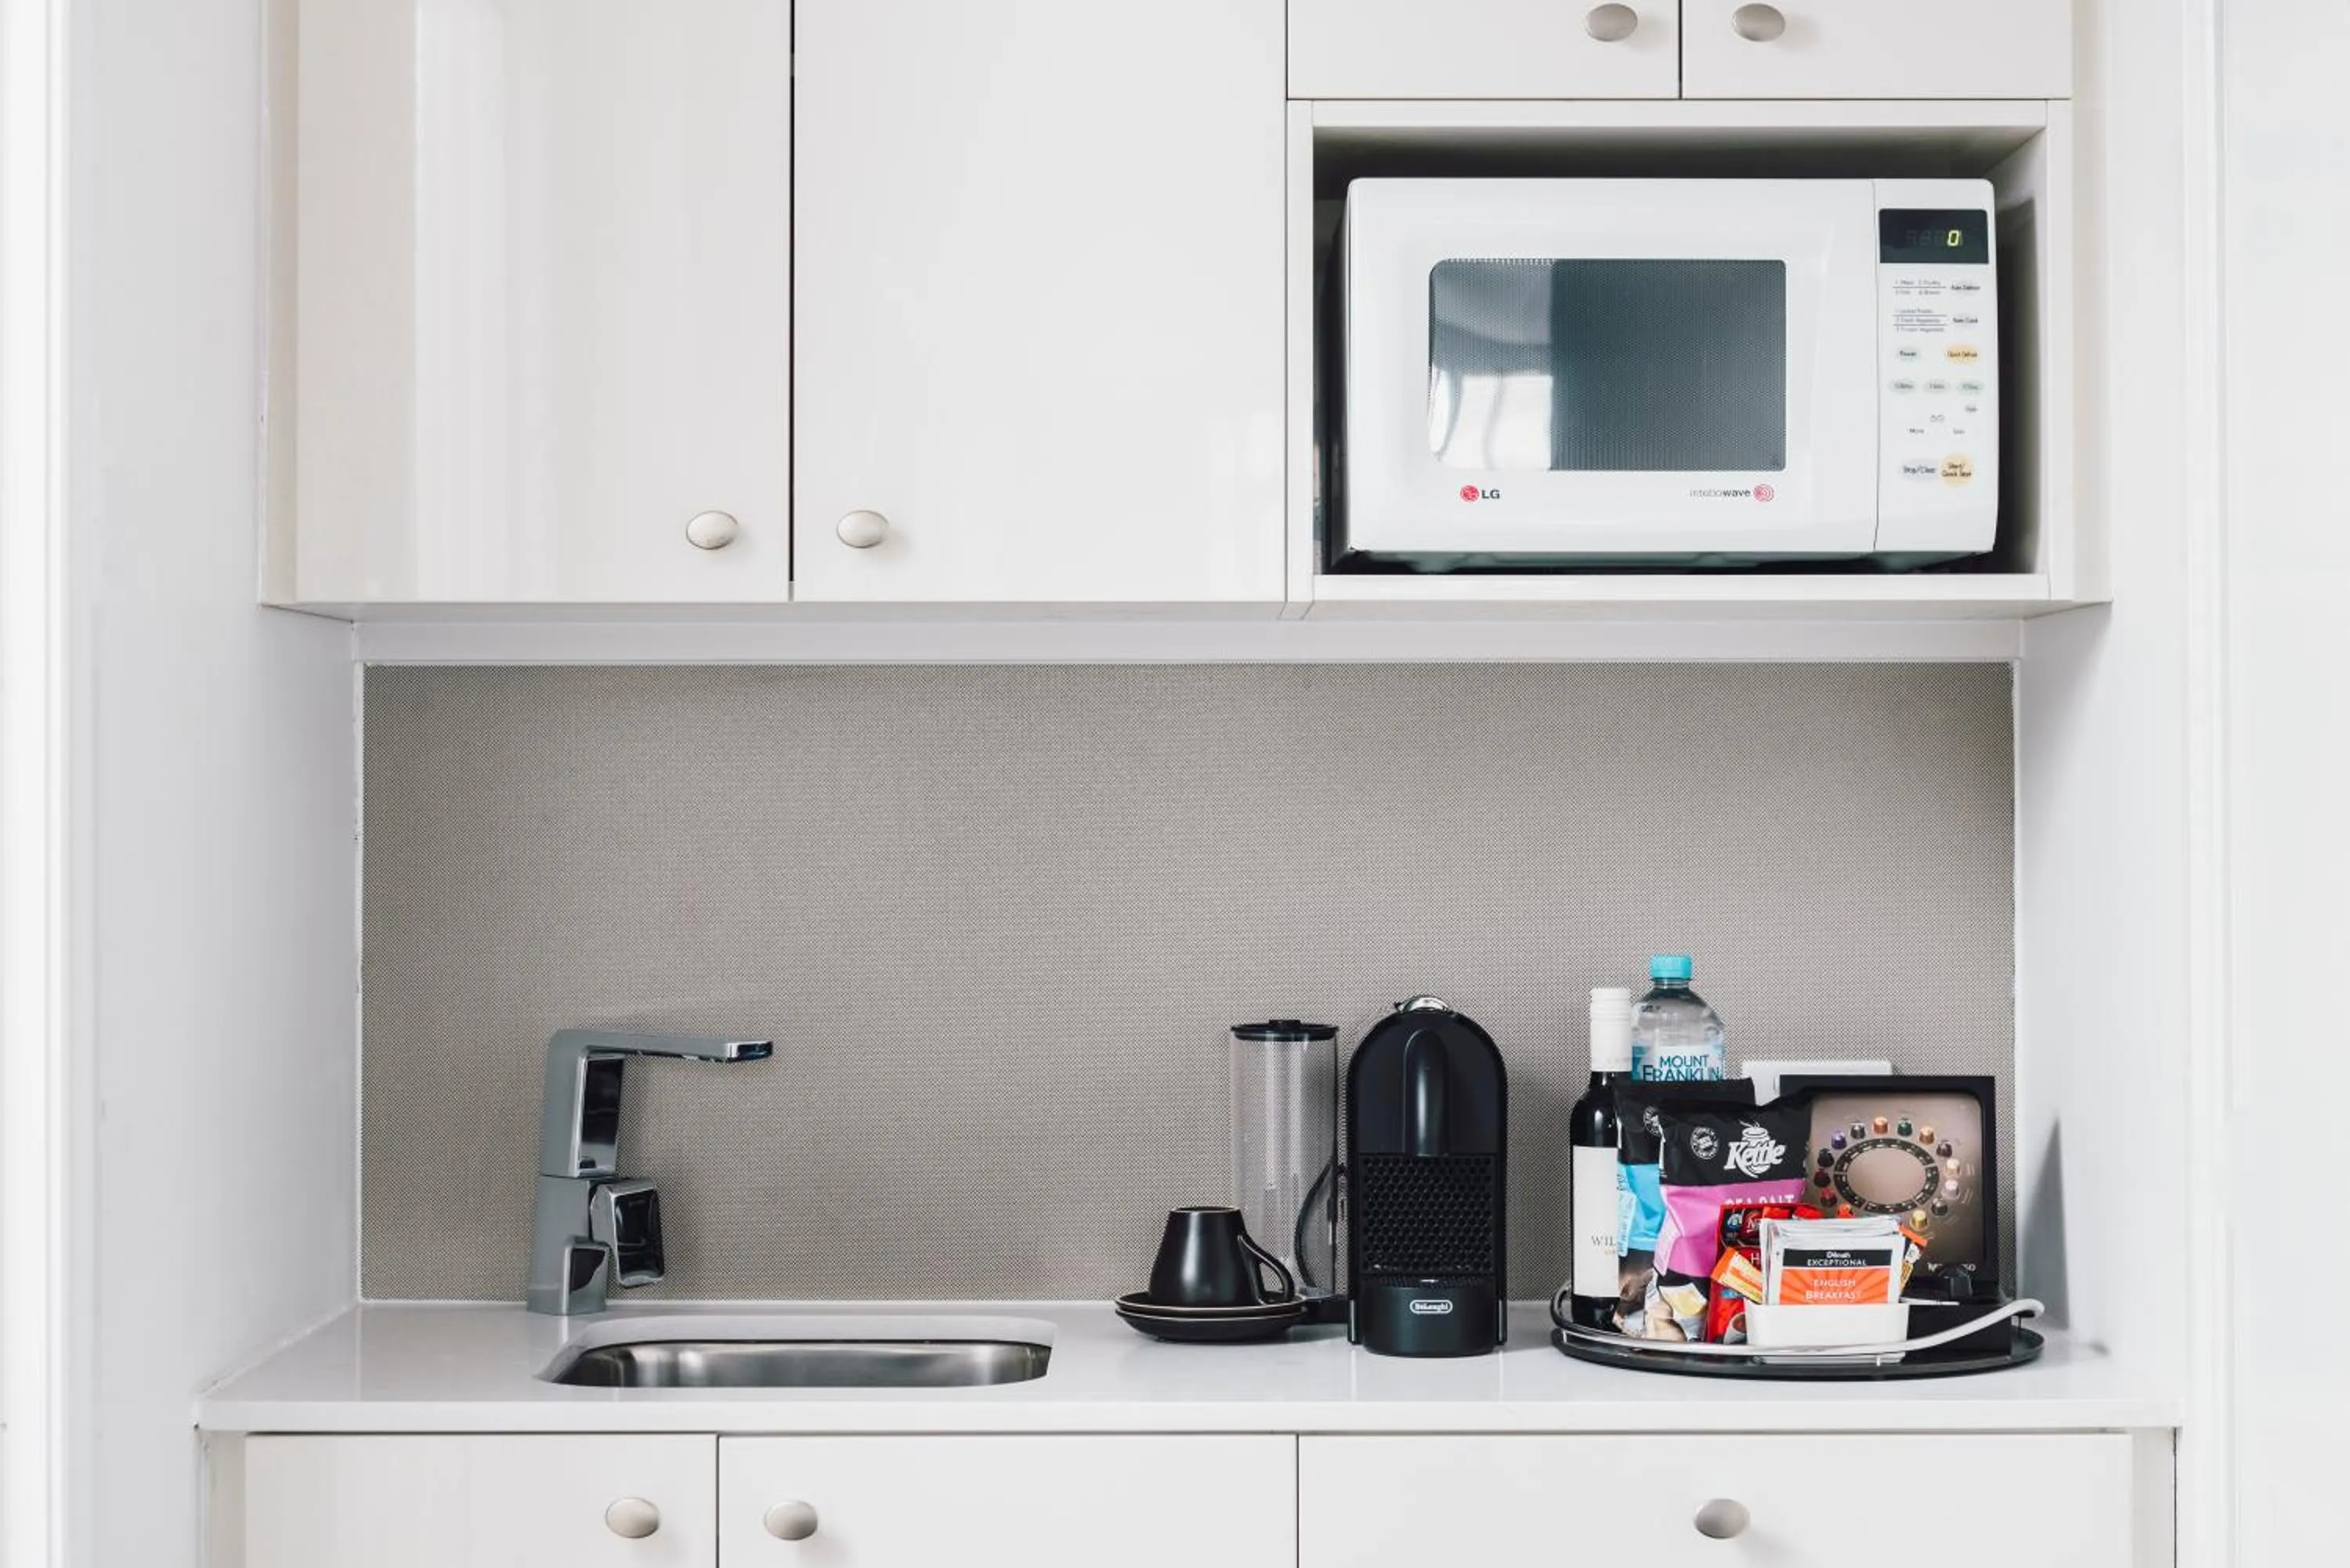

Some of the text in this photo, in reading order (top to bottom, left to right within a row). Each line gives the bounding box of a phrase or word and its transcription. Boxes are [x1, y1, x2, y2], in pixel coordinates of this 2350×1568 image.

[1481, 489, 1500, 499] LG
[1660, 1055, 1709, 1068] MOUNT
[1723, 1140, 1787, 1179] Kettle
[1806, 1290, 1862, 1299] BREAKFAST
